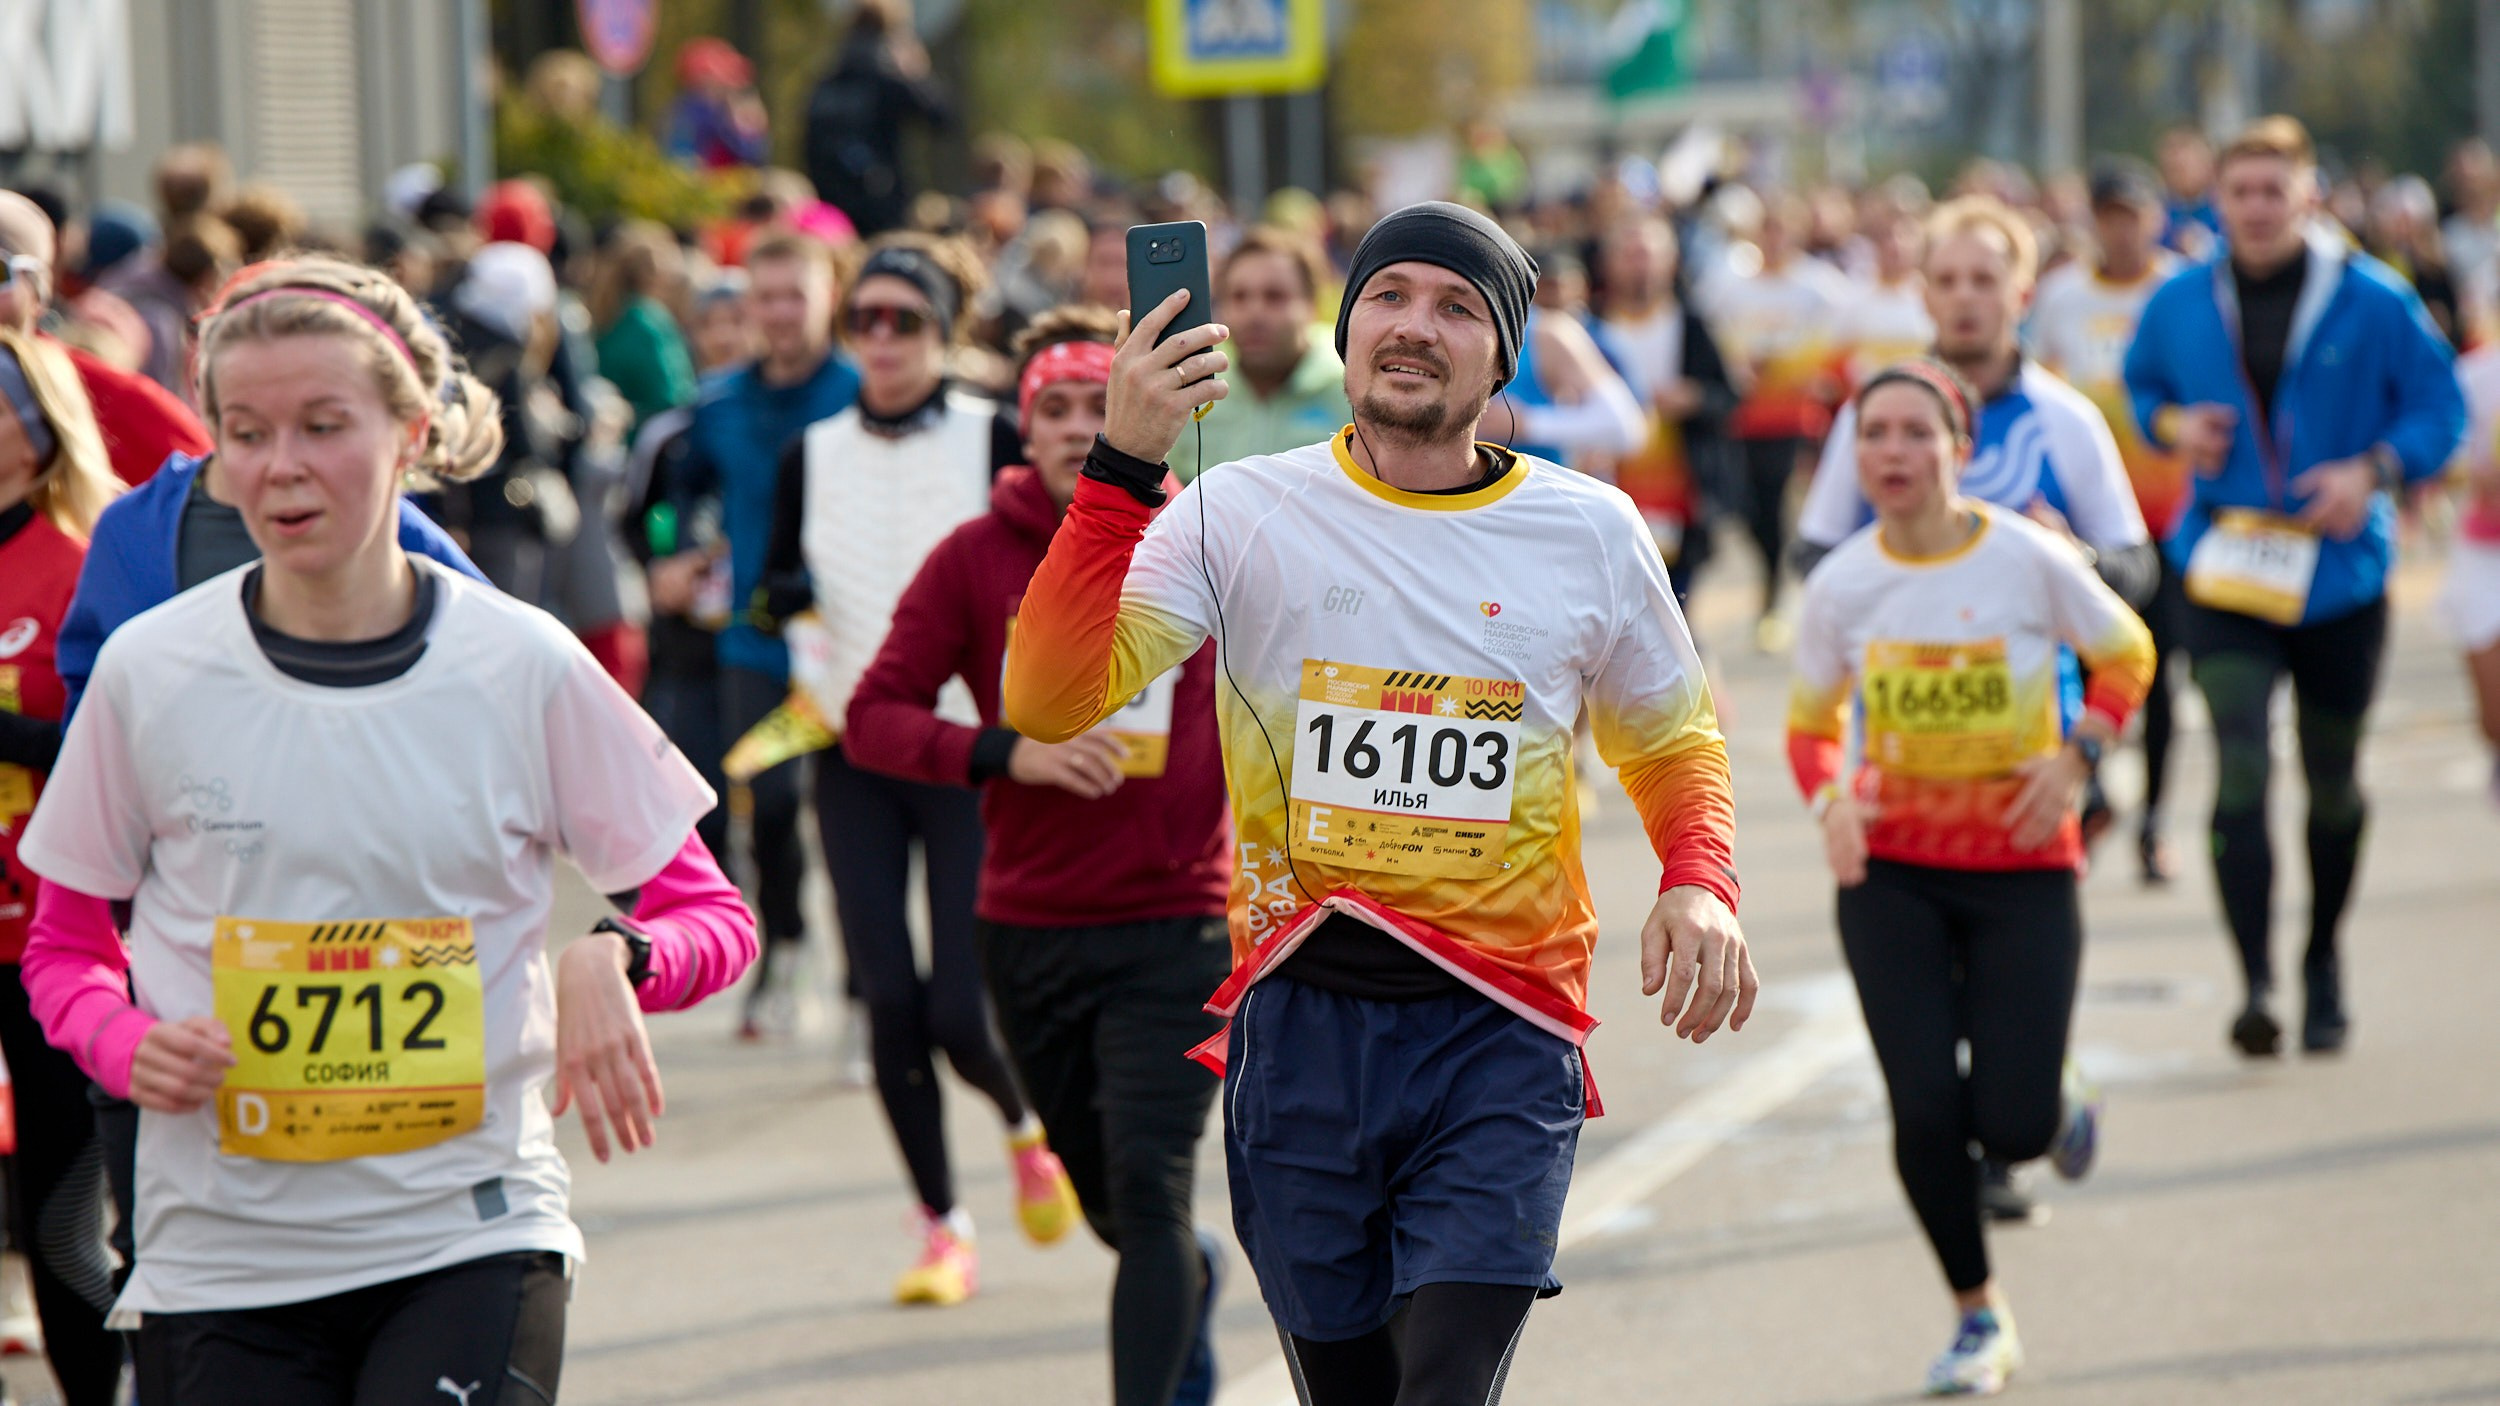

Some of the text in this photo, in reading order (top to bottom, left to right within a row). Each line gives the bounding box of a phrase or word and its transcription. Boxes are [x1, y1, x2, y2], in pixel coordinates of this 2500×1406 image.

[1484, 620, 1549, 639] МОСКОВСКИЙ
[1484, 629, 1531, 642] МАРАФОН
[1482, 645, 1532, 661] MARATHON
[1483, 637, 1525, 650] MOSCOW
[1464, 679, 1520, 698] 10 КМ
[1873, 672, 2009, 718] 16658
[1309, 713, 1509, 790] 16103
[1373, 788, 1428, 810] ИЛЬЯ
[1307, 806, 1332, 843] E
[1455, 831, 1486, 839] СИБУР
[1310, 846, 1345, 858] ФУТБОЛКА
[1443, 847, 1468, 855] МАГНИТ
[249, 981, 446, 1054] 6712
[304, 1061, 389, 1083] СОФИЯ
[236, 1093, 270, 1136] D
